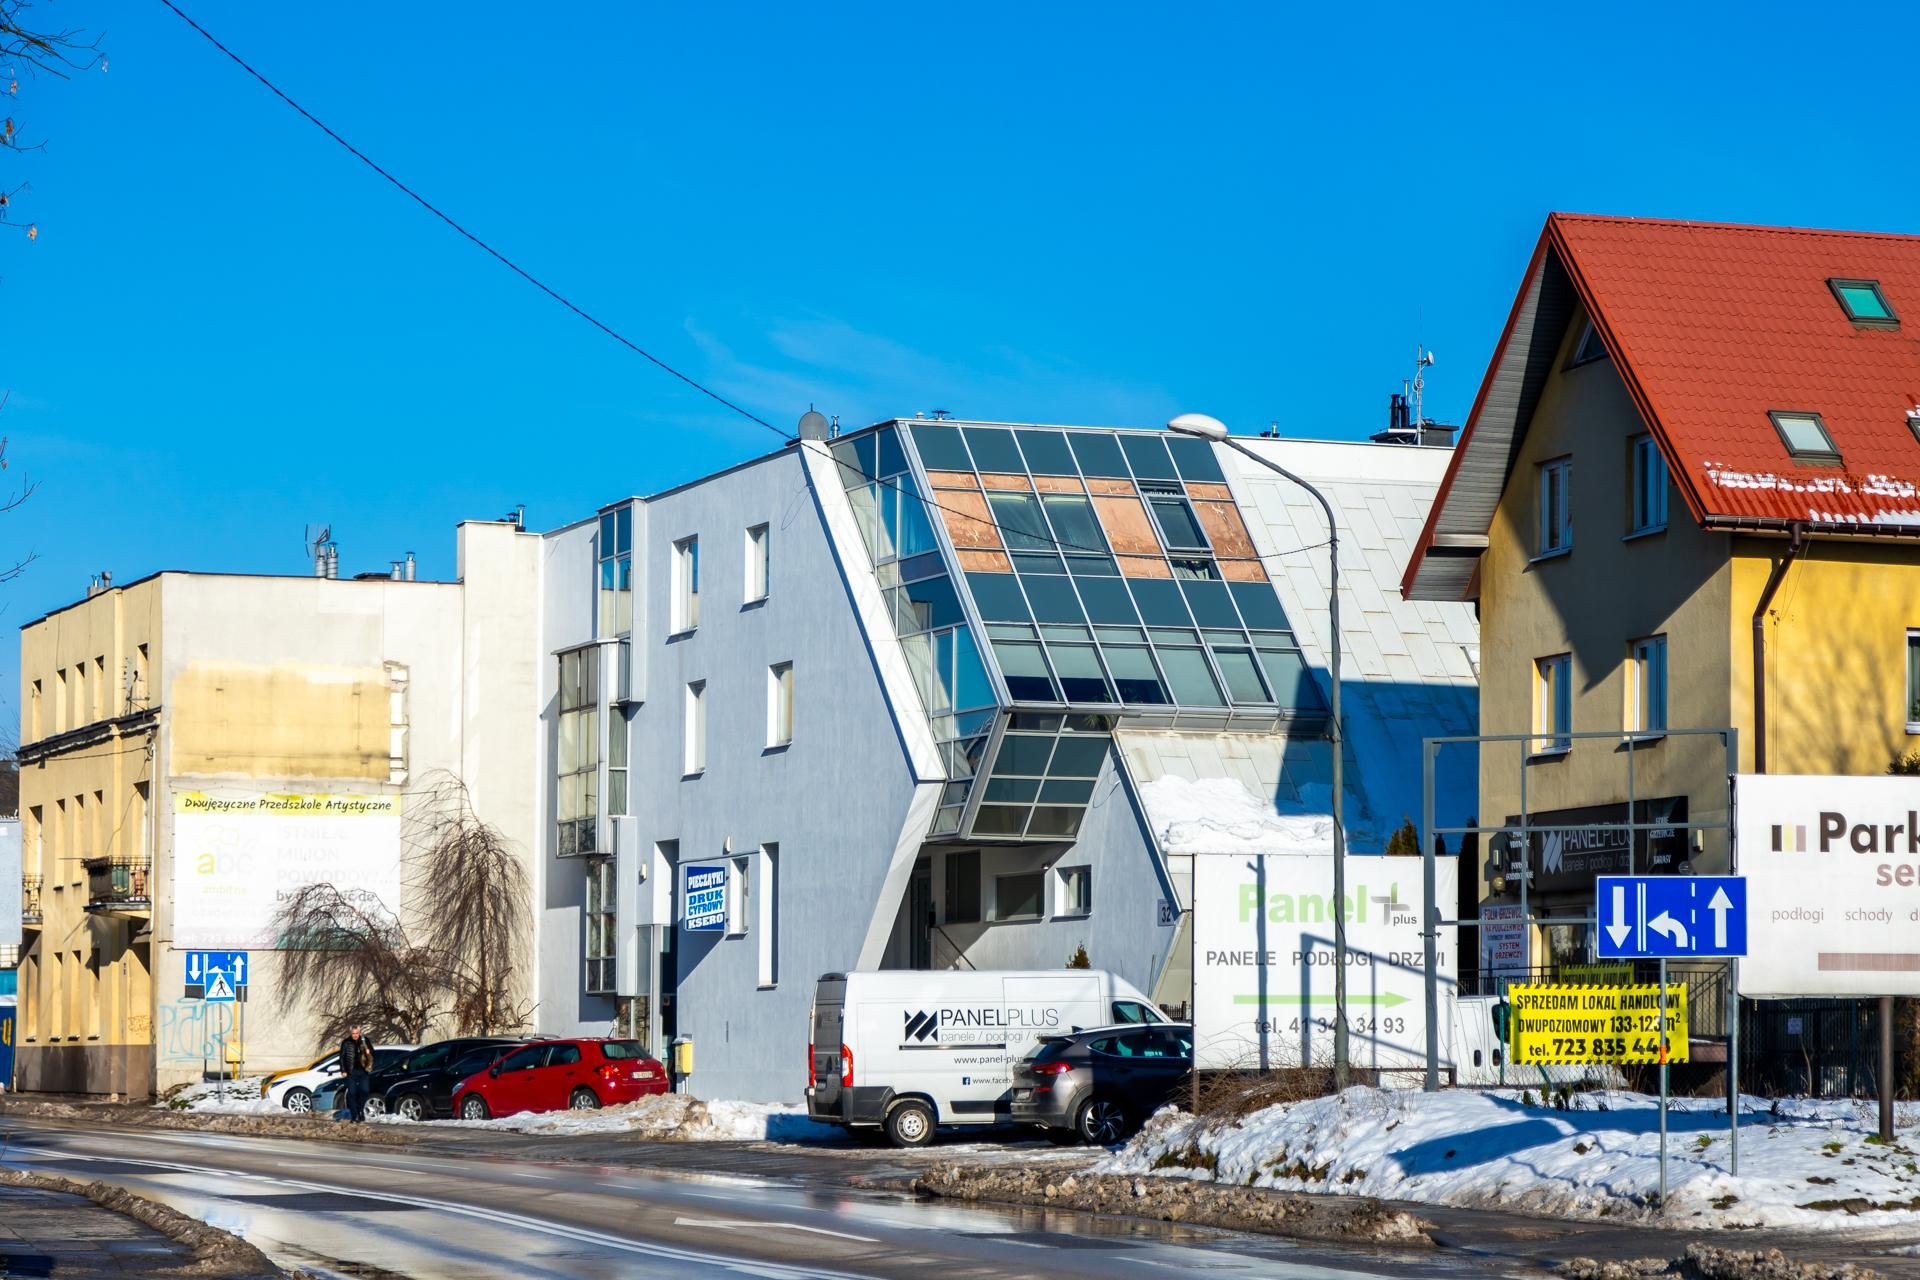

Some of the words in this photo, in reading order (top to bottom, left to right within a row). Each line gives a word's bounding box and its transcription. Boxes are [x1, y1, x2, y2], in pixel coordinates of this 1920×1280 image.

[185, 798, 256, 810] Dwujęzyczne
[259, 799, 322, 810] Przedszkole
[325, 800, 392, 813] Artystyczne
[688, 871, 724, 889] PIECZĄTKI
[1876, 863, 1920, 887] se
[689, 889, 723, 905] DRUK
[1239, 884, 1367, 924] Panel
[1393, 914, 1418, 926] plus
[688, 900, 723, 916] CYFROWY
[1162, 906, 1171, 923] 32
[1772, 907, 1824, 924] podłogi
[1845, 907, 1893, 924] schody
[688, 913, 723, 928] KSERO
[1499, 942, 1520, 950] SYSTEM
[1206, 951, 1277, 966] PANELE
[1388, 952, 1445, 967] DRZI
[1517, 994, 1578, 1010] SPRZEDAM
[1583, 994, 1616, 1010] LOKAL
[941, 1008, 1059, 1026] PANELPLUS
[1518, 1017, 1606, 1033] DWUPOZIOMOWY
[1254, 1017, 1282, 1034] tel.
[1289, 1017, 1310, 1033] 41
[1318, 1017, 1344, 1033] 34
[1356, 1017, 1377, 1033] 34
[1383, 1017, 1405, 1033] 93
[941, 1031, 975, 1043] panele
[1529, 1044, 1550, 1056] tel.
[1553, 1038, 1586, 1056] 723
[1592, 1038, 1627, 1056] 835
